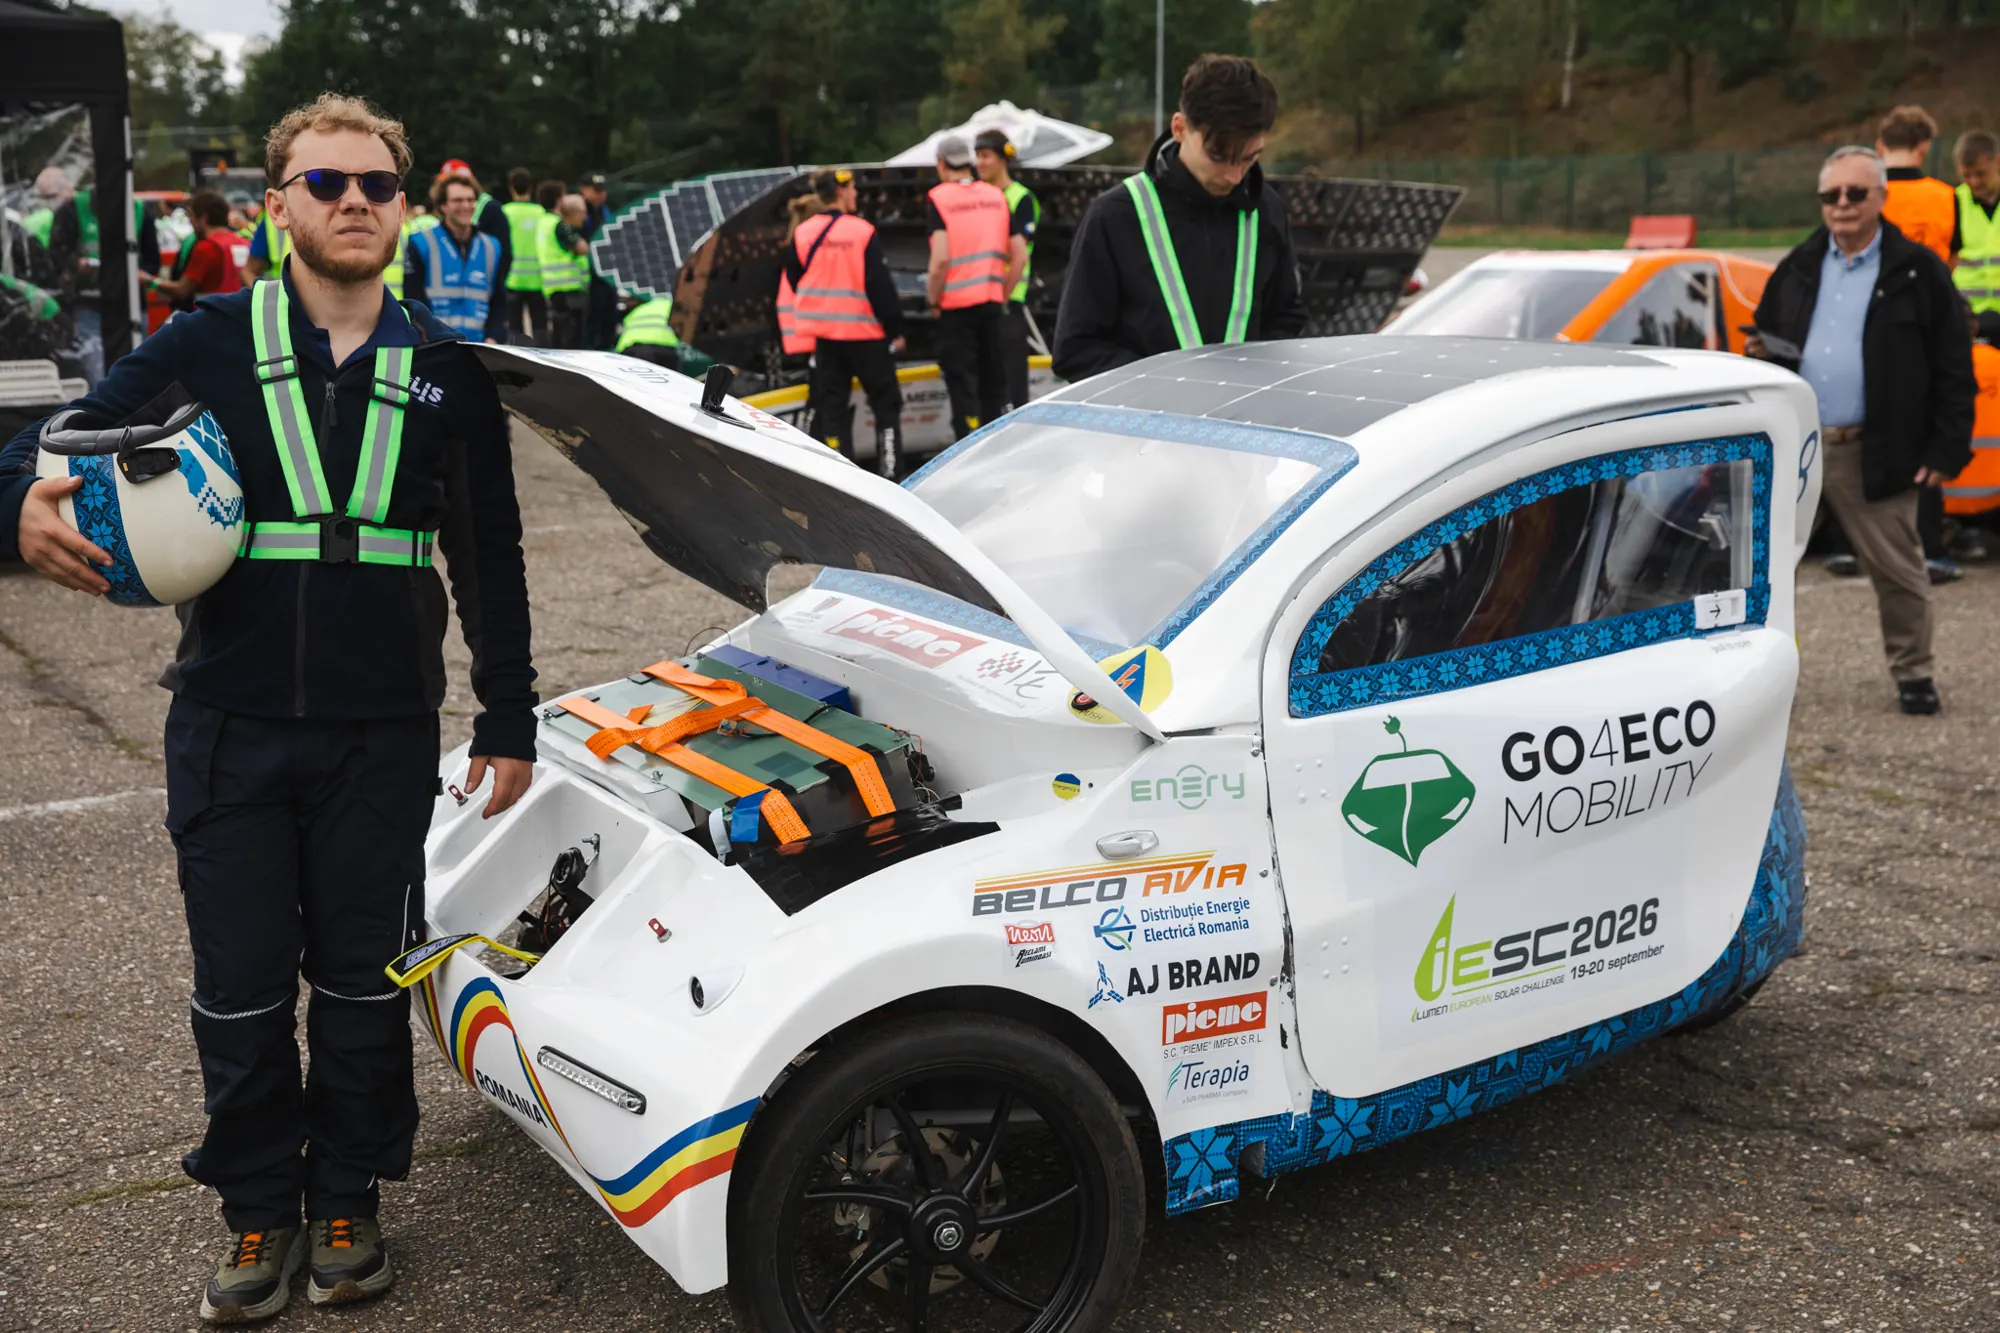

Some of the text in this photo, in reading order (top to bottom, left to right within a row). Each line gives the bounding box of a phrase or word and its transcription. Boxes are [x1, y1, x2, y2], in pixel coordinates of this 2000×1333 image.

[828, 613, 962, 657] pieme
[1502, 699, 1716, 782] GO4ECO
[1503, 752, 1713, 844] MOBILITY
[1142, 860, 1248, 897] AVIA
[1207, 897, 1250, 916] Energie
[1144, 917, 1250, 943] Electrică Romania
[1127, 952, 1260, 997] AJ BRAND
[1570, 944, 1665, 980] 19-20 september
[1450, 995, 1493, 1013] EUROPEAN
[1494, 986, 1520, 1001] SOLAR
[1521, 975, 1566, 994] CHALLENGE
[1165, 1001, 1263, 1045] pieme
[1163, 1048, 1179, 1060] S.C.
[1213, 1036, 1239, 1050] IMPEX
[1181, 1059, 1249, 1090] Terapia
[475, 1068, 548, 1129] ROMANIA
[1198, 1091, 1221, 1101] PHARMA
[1222, 1088, 1248, 1098] company
